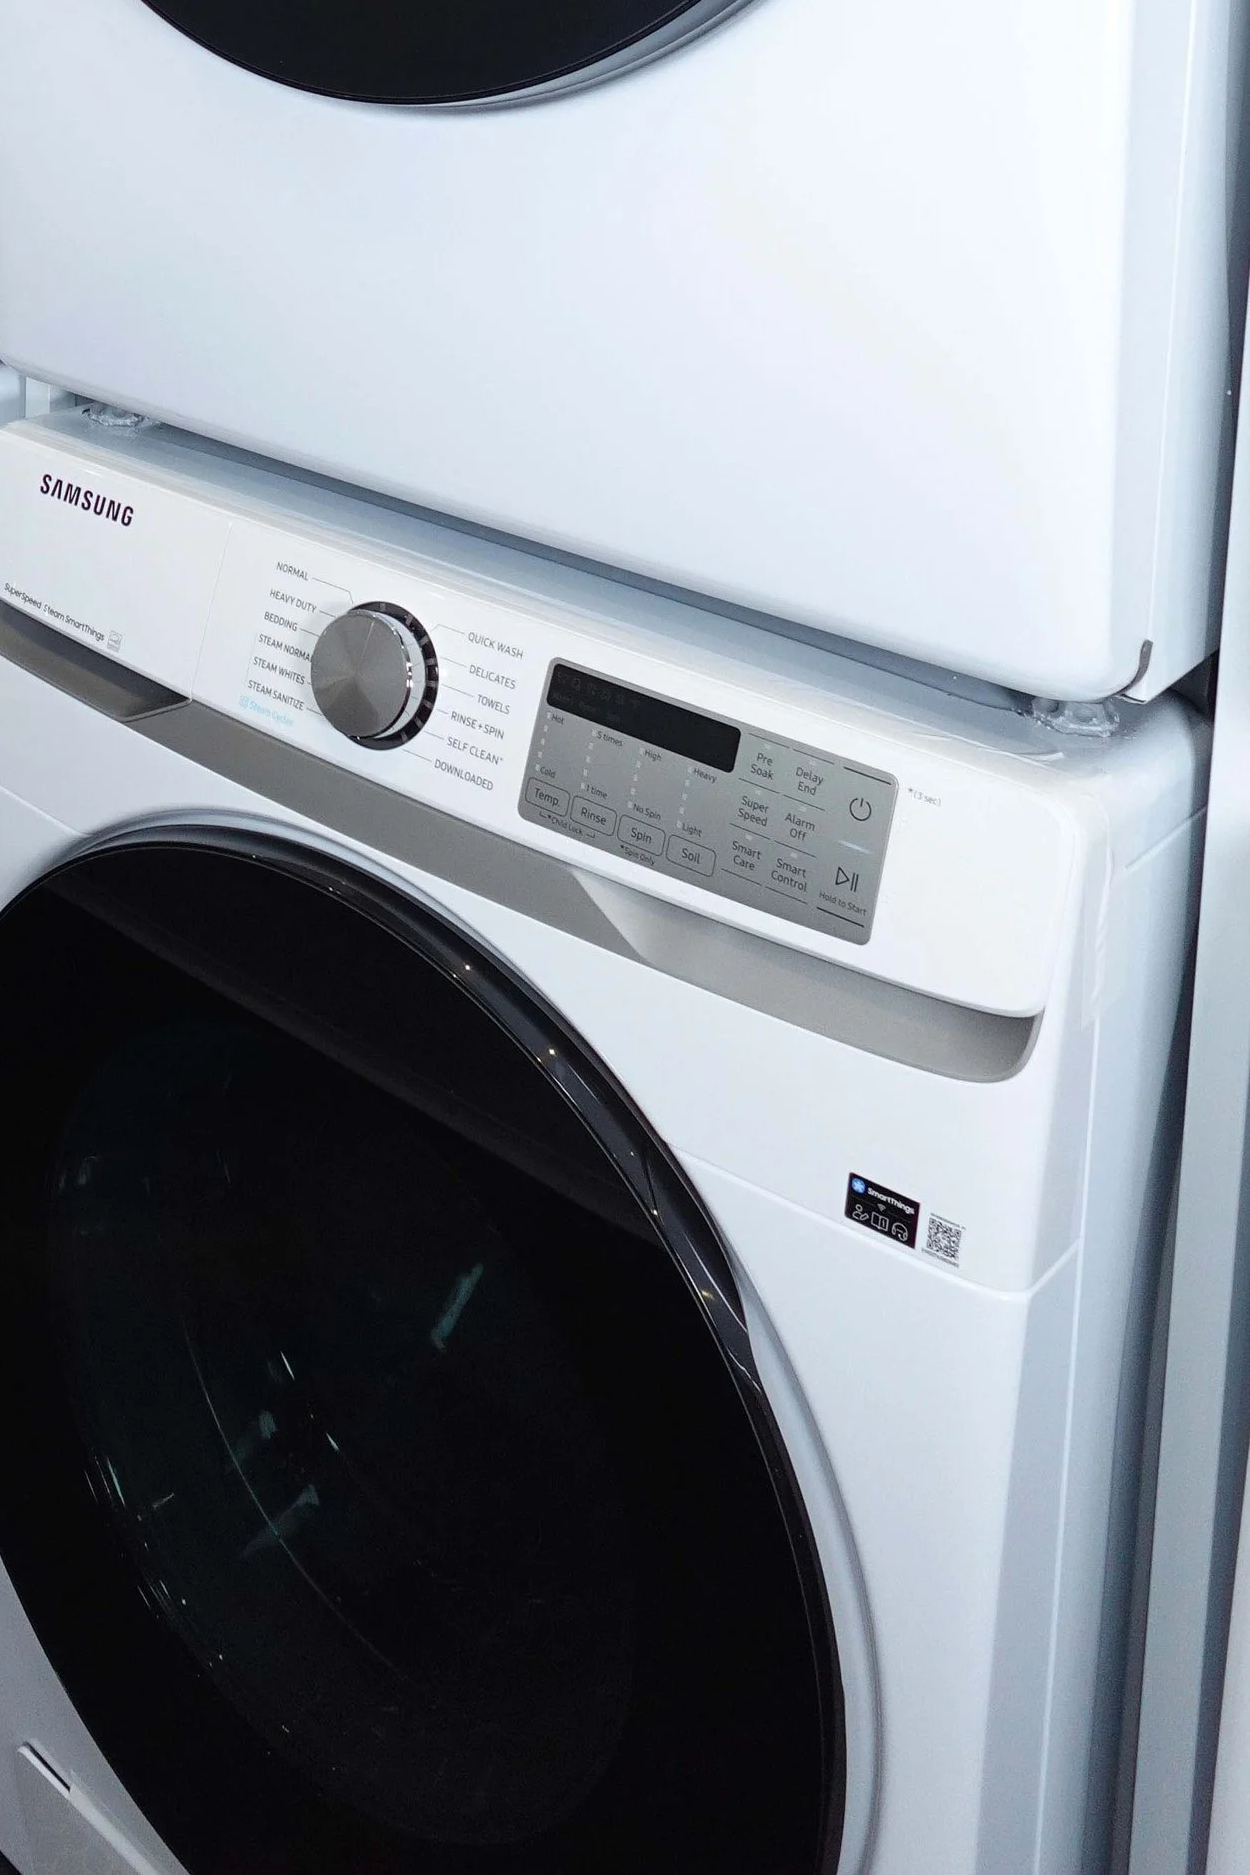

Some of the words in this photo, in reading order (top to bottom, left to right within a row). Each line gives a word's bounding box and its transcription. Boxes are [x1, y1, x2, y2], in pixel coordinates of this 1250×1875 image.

[39, 473, 135, 527] SAMSUNG
[277, 561, 309, 581] NORMAL
[270, 588, 296, 605] HEAVY
[295, 598, 318, 614] DUTY
[4, 582, 42, 609] SuperSpeed
[43, 604, 65, 621] Steam
[65, 615, 105, 642] SmartThings
[264, 611, 298, 632] BEDDING
[258, 634, 283, 650] STEAM
[284, 644, 312, 663] NORMA
[468, 631, 495, 649] QUICK
[497, 642, 524, 660] WASH
[253, 656, 278, 673] STEAM
[278, 665, 305, 685] WHITES
[469, 664, 516, 690] DELICATES
[248, 680, 273, 697] STEAM
[273, 690, 305, 711] SANITIZE
[477, 694, 511, 715] TOWELS
[450, 710, 477, 729] RINSE
[483, 723, 505, 740] SPIN
[552, 713, 565, 725] Hot
[447, 736, 468, 752] SELF
[602, 733, 623, 747] times
[645, 748, 662, 762] High
[757, 752, 773, 766] Pre
[434, 758, 494, 791] DOWNLOADED
[540, 766, 556, 779] Cold
[694, 767, 717, 784] Heavy
[750, 763, 774, 780] Soak
[796, 766, 824, 786] Delay
[591, 786, 608, 799] time
[797, 780, 817, 796] End
[741, 795, 769, 814] Super
[925, 793, 942, 807] sec)
[580, 806, 607, 826] Rinse
[633, 803, 644, 814] No
[644, 807, 662, 822] Spin
[738, 807, 768, 827] Speed
[785, 812, 815, 831] Alarm
[568, 824, 584, 837] Lock
[630, 827, 652, 845] Spin
[682, 822, 703, 838] Light
[789, 827, 807, 842] Off
[639, 852, 655, 867] Only
[681, 847, 701, 865] Soil
[731, 840, 763, 860] Smart
[733, 855, 755, 871] Care
[776, 858, 807, 878] Smart
[771, 870, 808, 893] Control
[819, 891, 838, 905] Hold
[838, 898, 847, 907] to
[847, 901, 868, 916] Start
[867, 1187, 915, 1215] SmartThings
